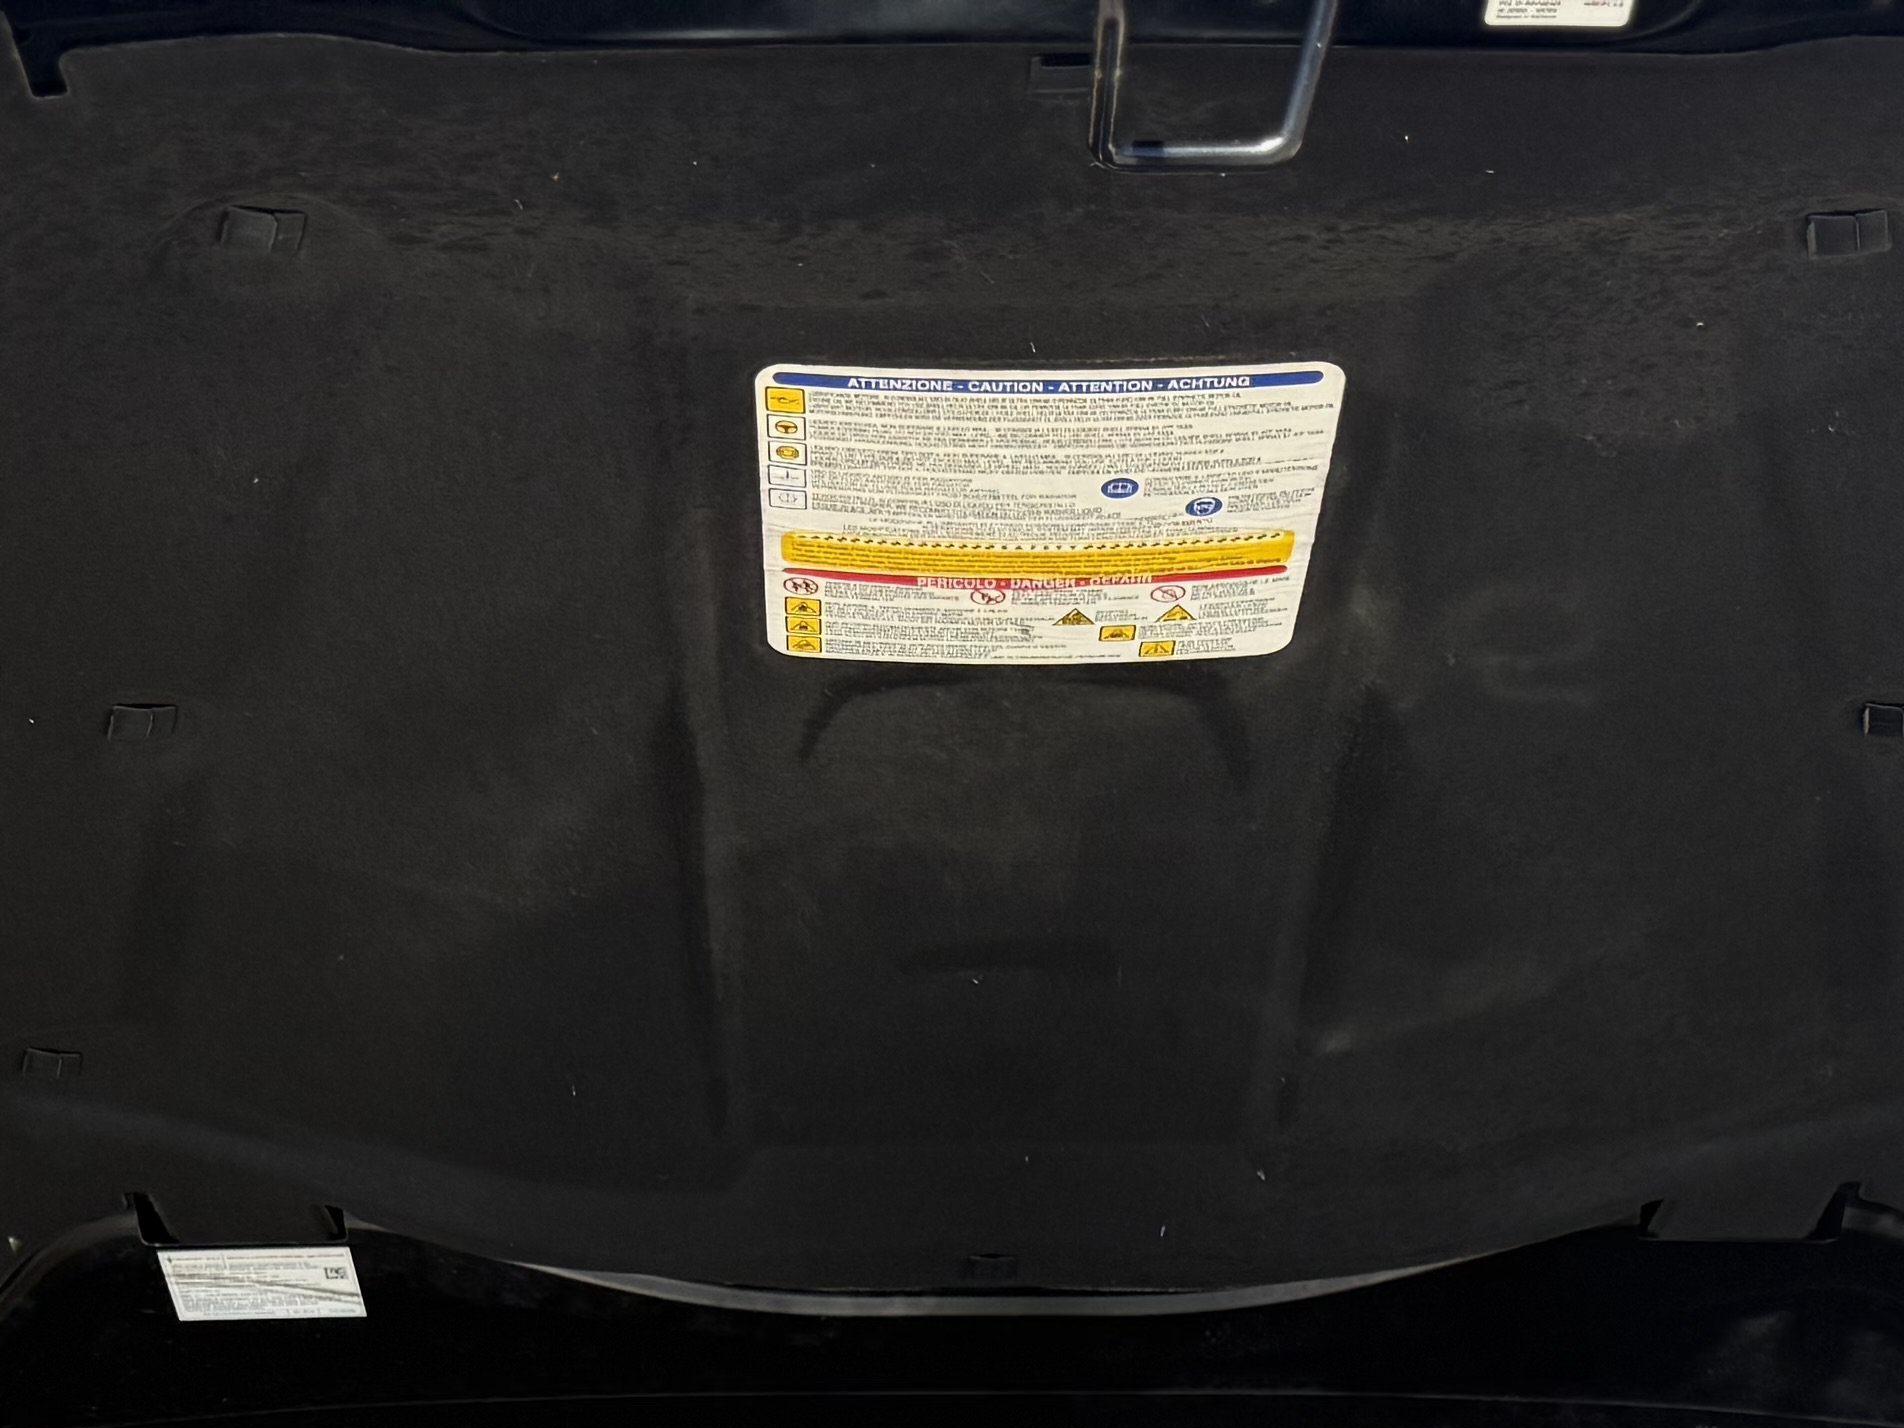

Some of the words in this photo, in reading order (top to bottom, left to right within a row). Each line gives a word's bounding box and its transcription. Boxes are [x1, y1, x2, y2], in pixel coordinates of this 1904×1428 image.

[848, 377, 953, 392] ATTENZIONE
[968, 380, 1044, 393] CAUTION
[1058, 380, 1153, 393] ATTENTION
[1169, 376, 1250, 389] ACHTUNG
[917, 577, 995, 588] PERICOLO
[1010, 578, 1076, 590] DANGER
